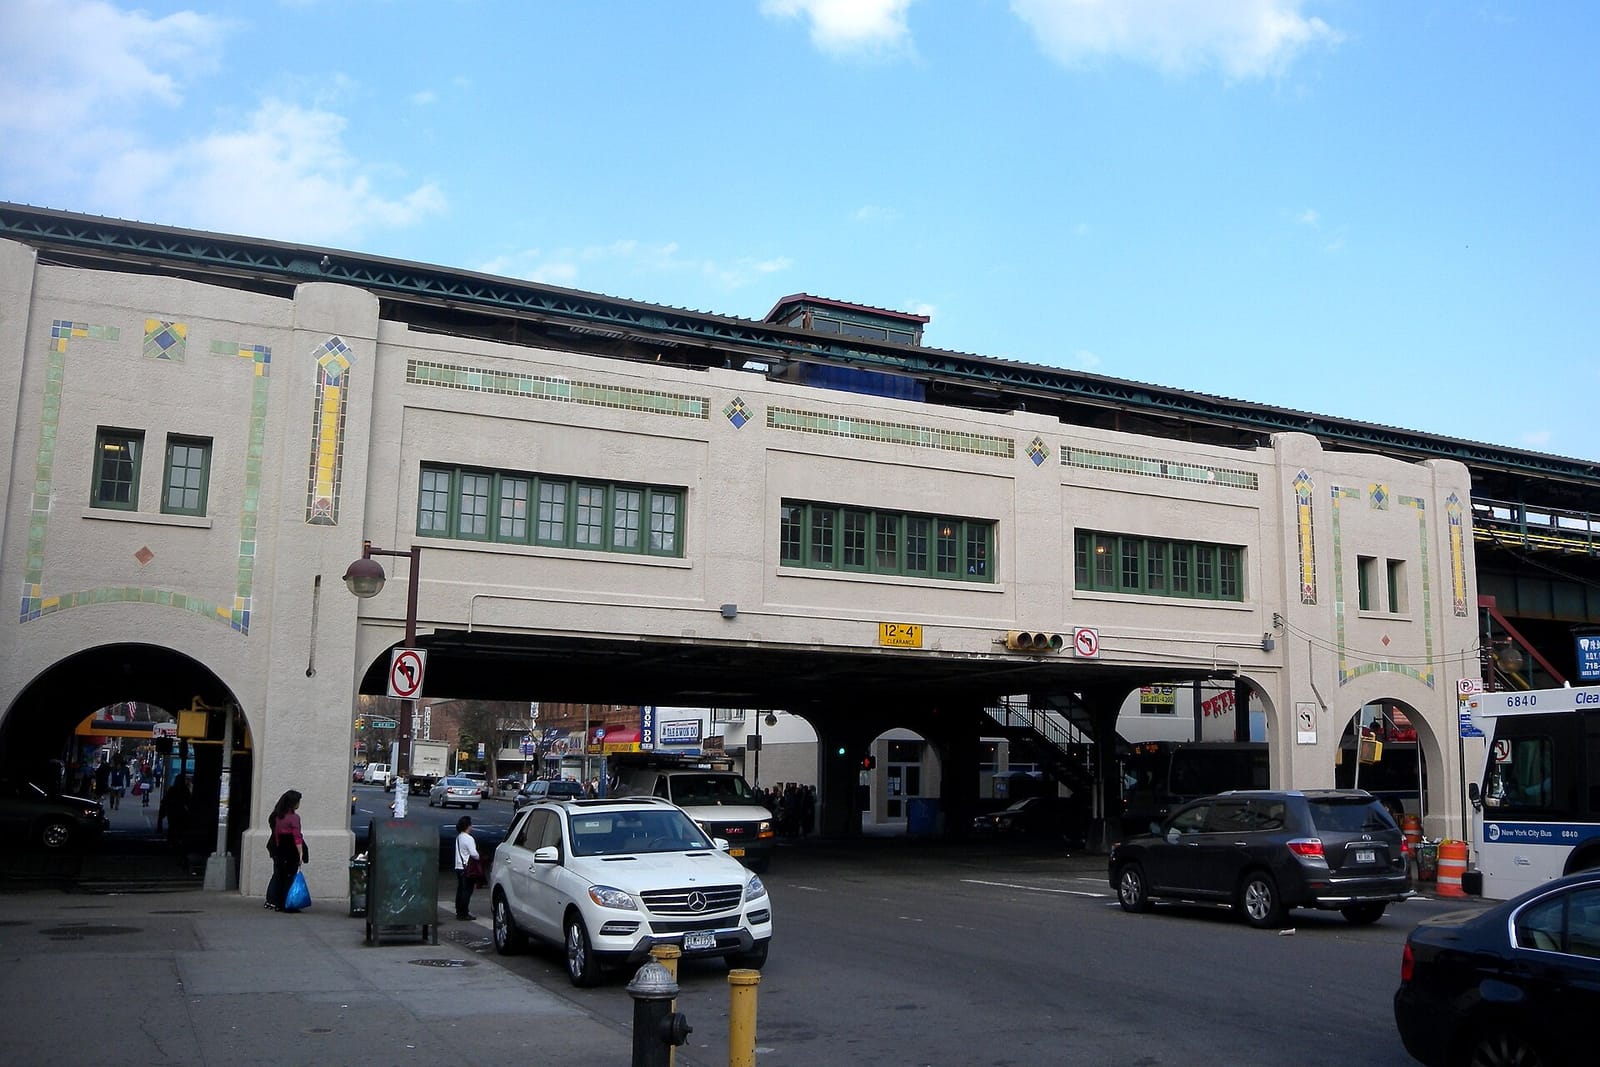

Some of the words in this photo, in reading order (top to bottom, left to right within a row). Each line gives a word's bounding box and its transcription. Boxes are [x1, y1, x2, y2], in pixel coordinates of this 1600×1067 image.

[1507, 695, 1537, 708] 6840
[644, 729, 652, 743] DO
[690, 727, 698, 737] DO
[1528, 829, 1540, 838] City
[1561, 830, 1578, 838] 6840
